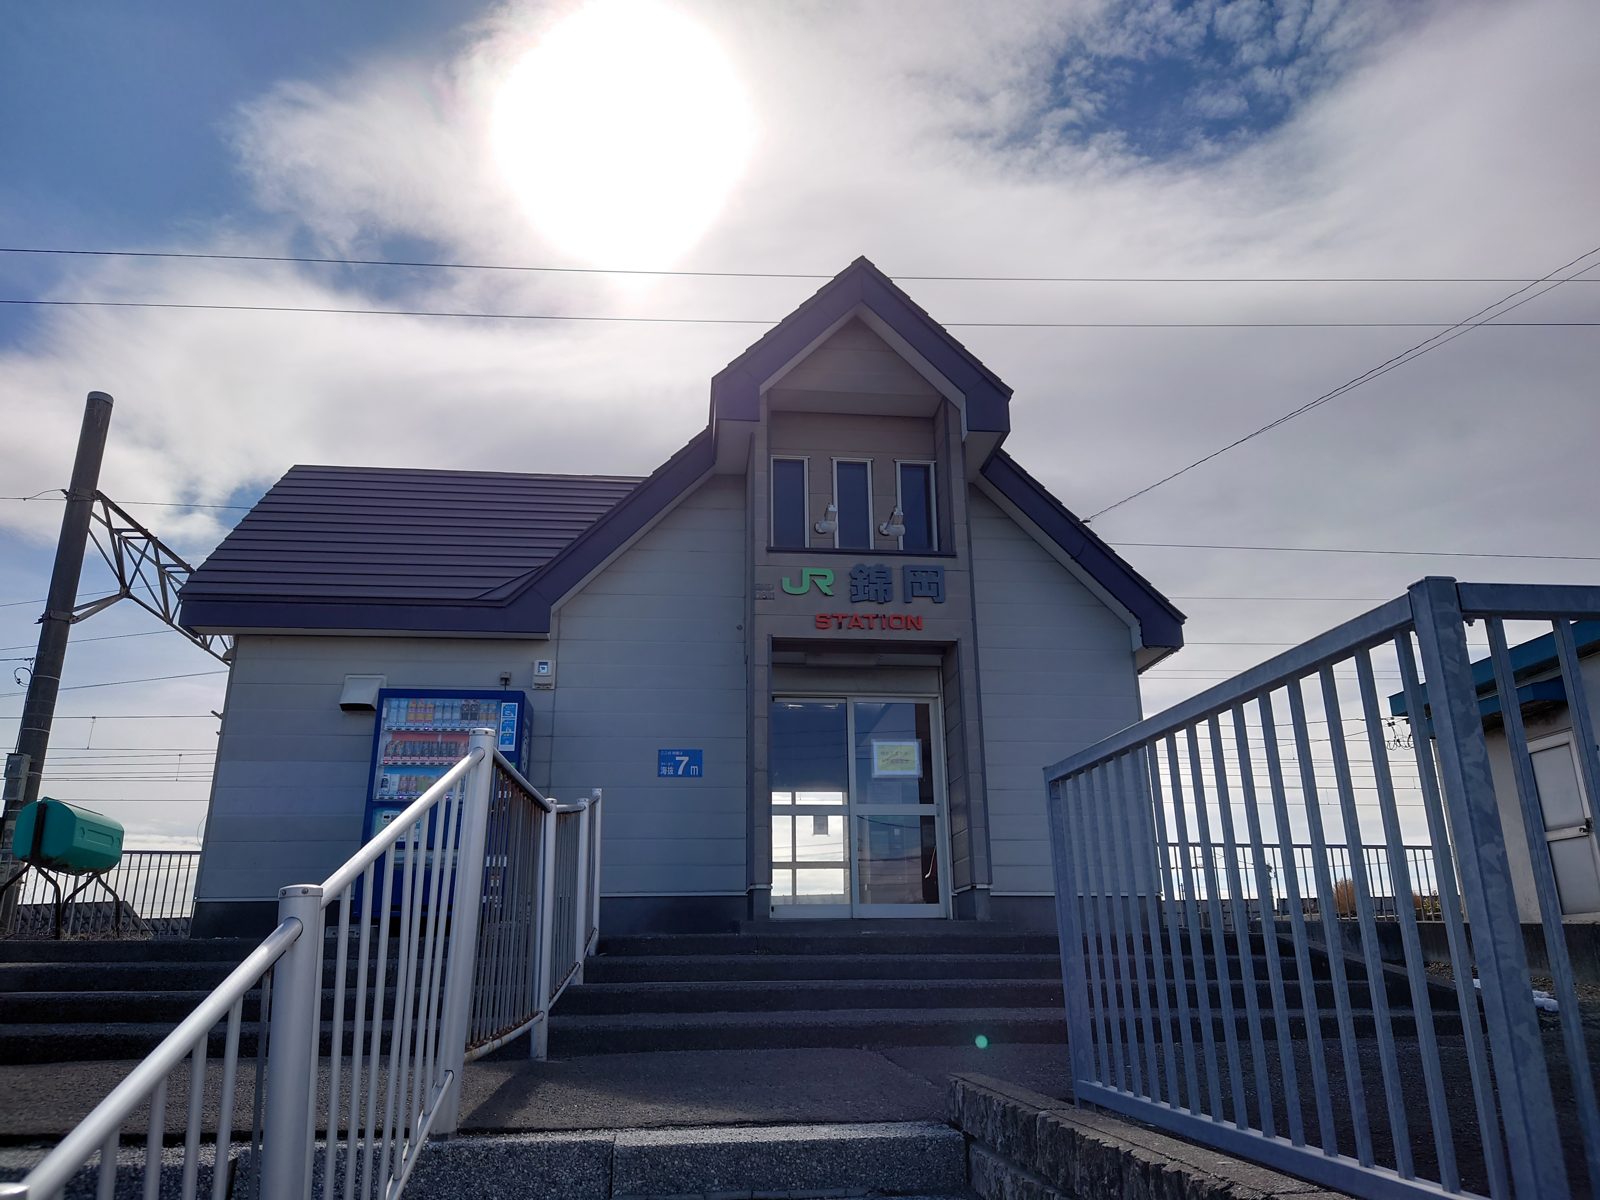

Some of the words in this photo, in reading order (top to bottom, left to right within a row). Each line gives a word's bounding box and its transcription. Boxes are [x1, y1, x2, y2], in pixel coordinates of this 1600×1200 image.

[781, 567, 834, 596] JR
[849, 563, 946, 604] 錦岡
[815, 613, 923, 631] STATION
[676, 756, 688, 775] 7
